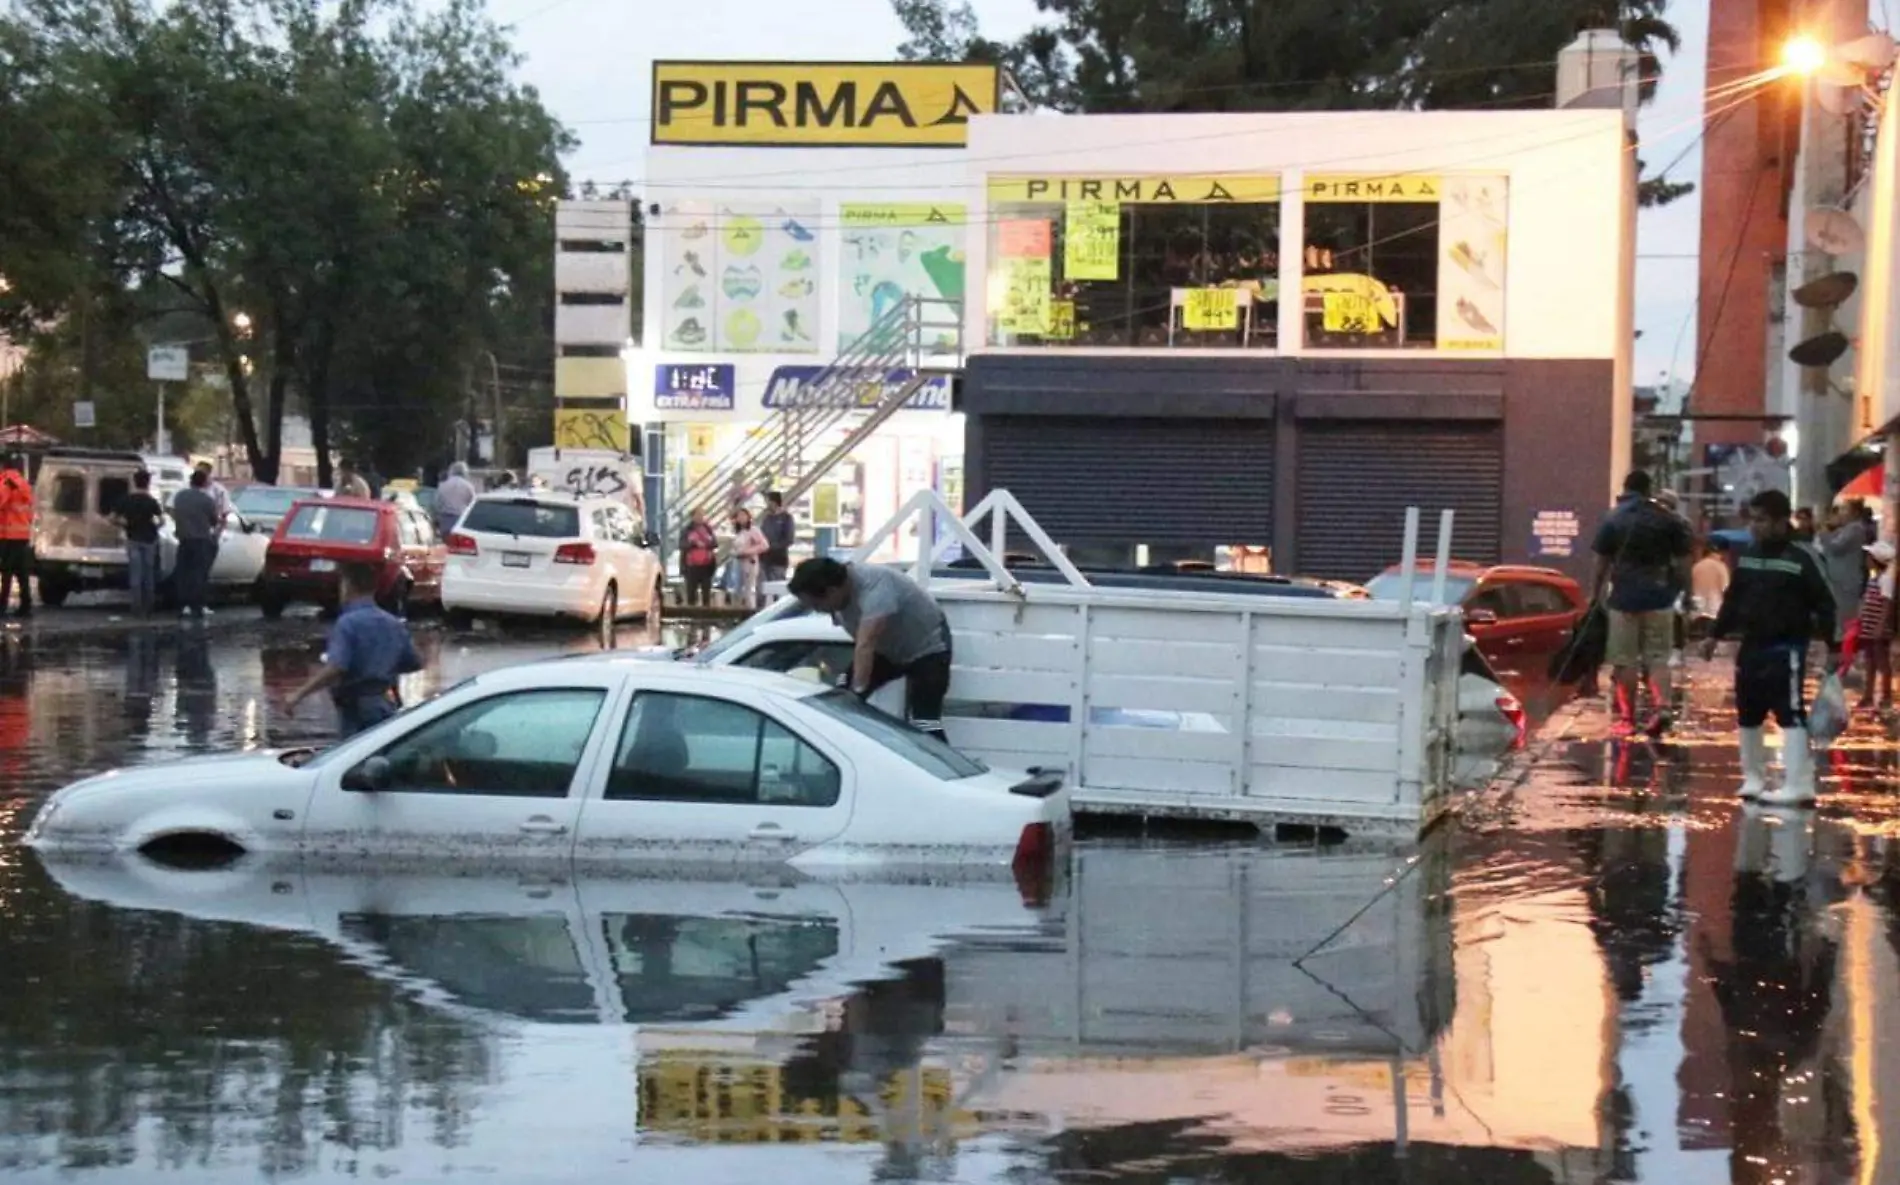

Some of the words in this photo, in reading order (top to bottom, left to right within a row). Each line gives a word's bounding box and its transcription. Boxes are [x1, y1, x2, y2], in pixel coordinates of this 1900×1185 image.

[658, 80, 917, 128] PIRMA
[1027, 179, 1177, 200] PIRMA
[1312, 182, 1404, 196] PIRMA
[845, 210, 897, 220] PIRMA
